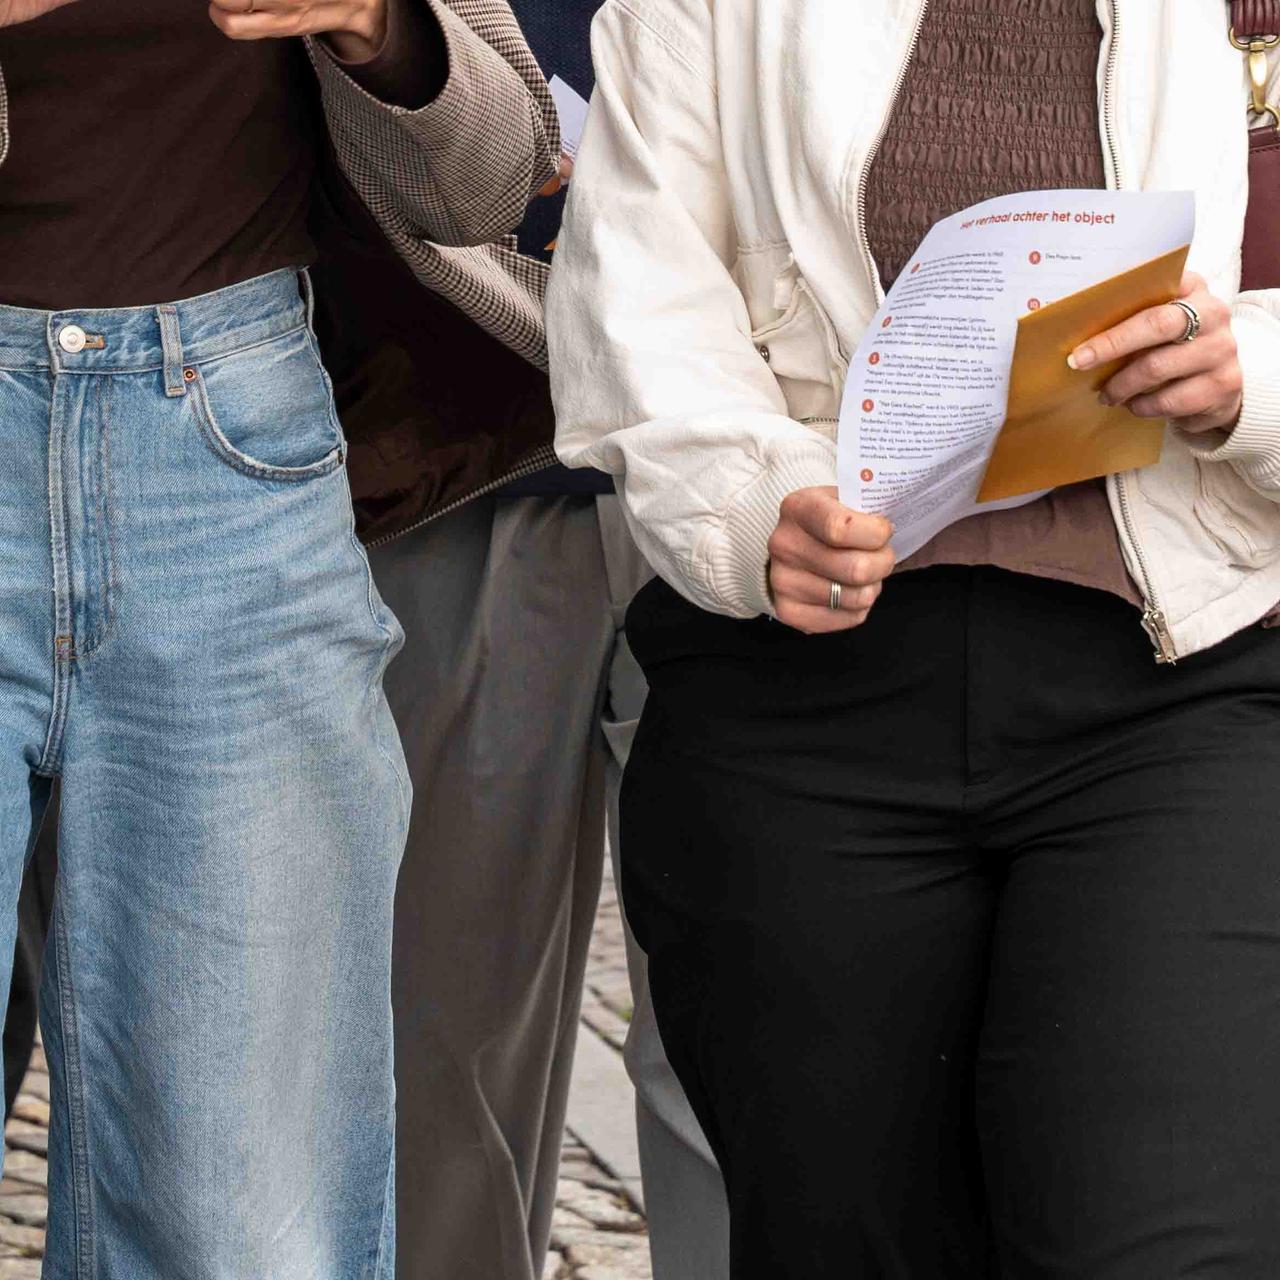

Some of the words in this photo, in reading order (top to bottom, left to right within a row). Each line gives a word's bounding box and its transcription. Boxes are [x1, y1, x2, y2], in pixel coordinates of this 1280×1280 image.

[1012, 210, 1048, 223] achter
[1051, 210, 1071, 223] het
[1074, 211, 1116, 226] object
